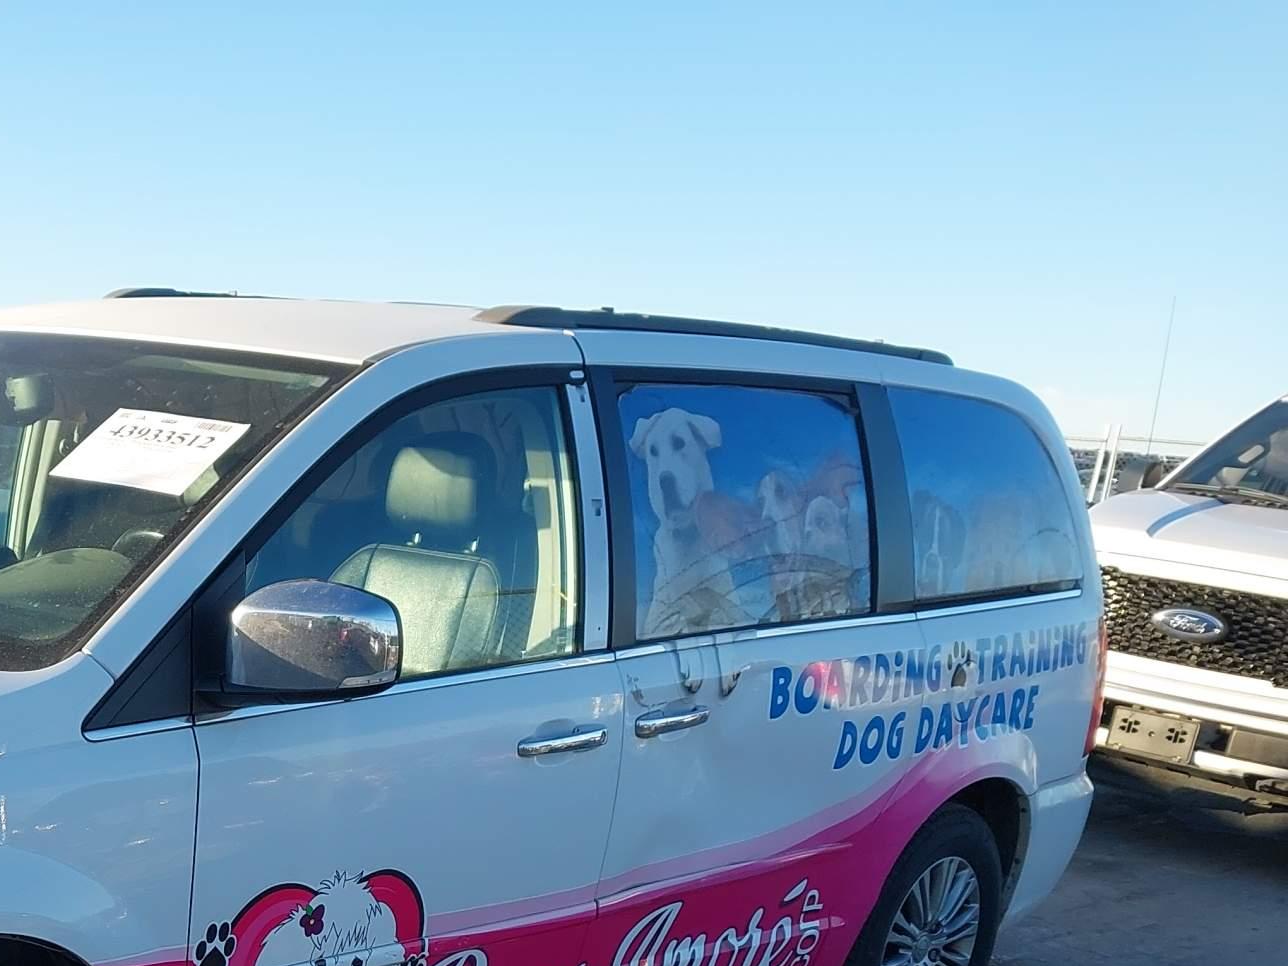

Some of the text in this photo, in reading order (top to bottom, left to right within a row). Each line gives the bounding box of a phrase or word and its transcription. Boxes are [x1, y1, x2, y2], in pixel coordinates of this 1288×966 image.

[110, 424, 216, 449] 43933512
[1169, 614, 1208, 634] Ford
[832, 685, 1040, 770] DOG DAYCARE
